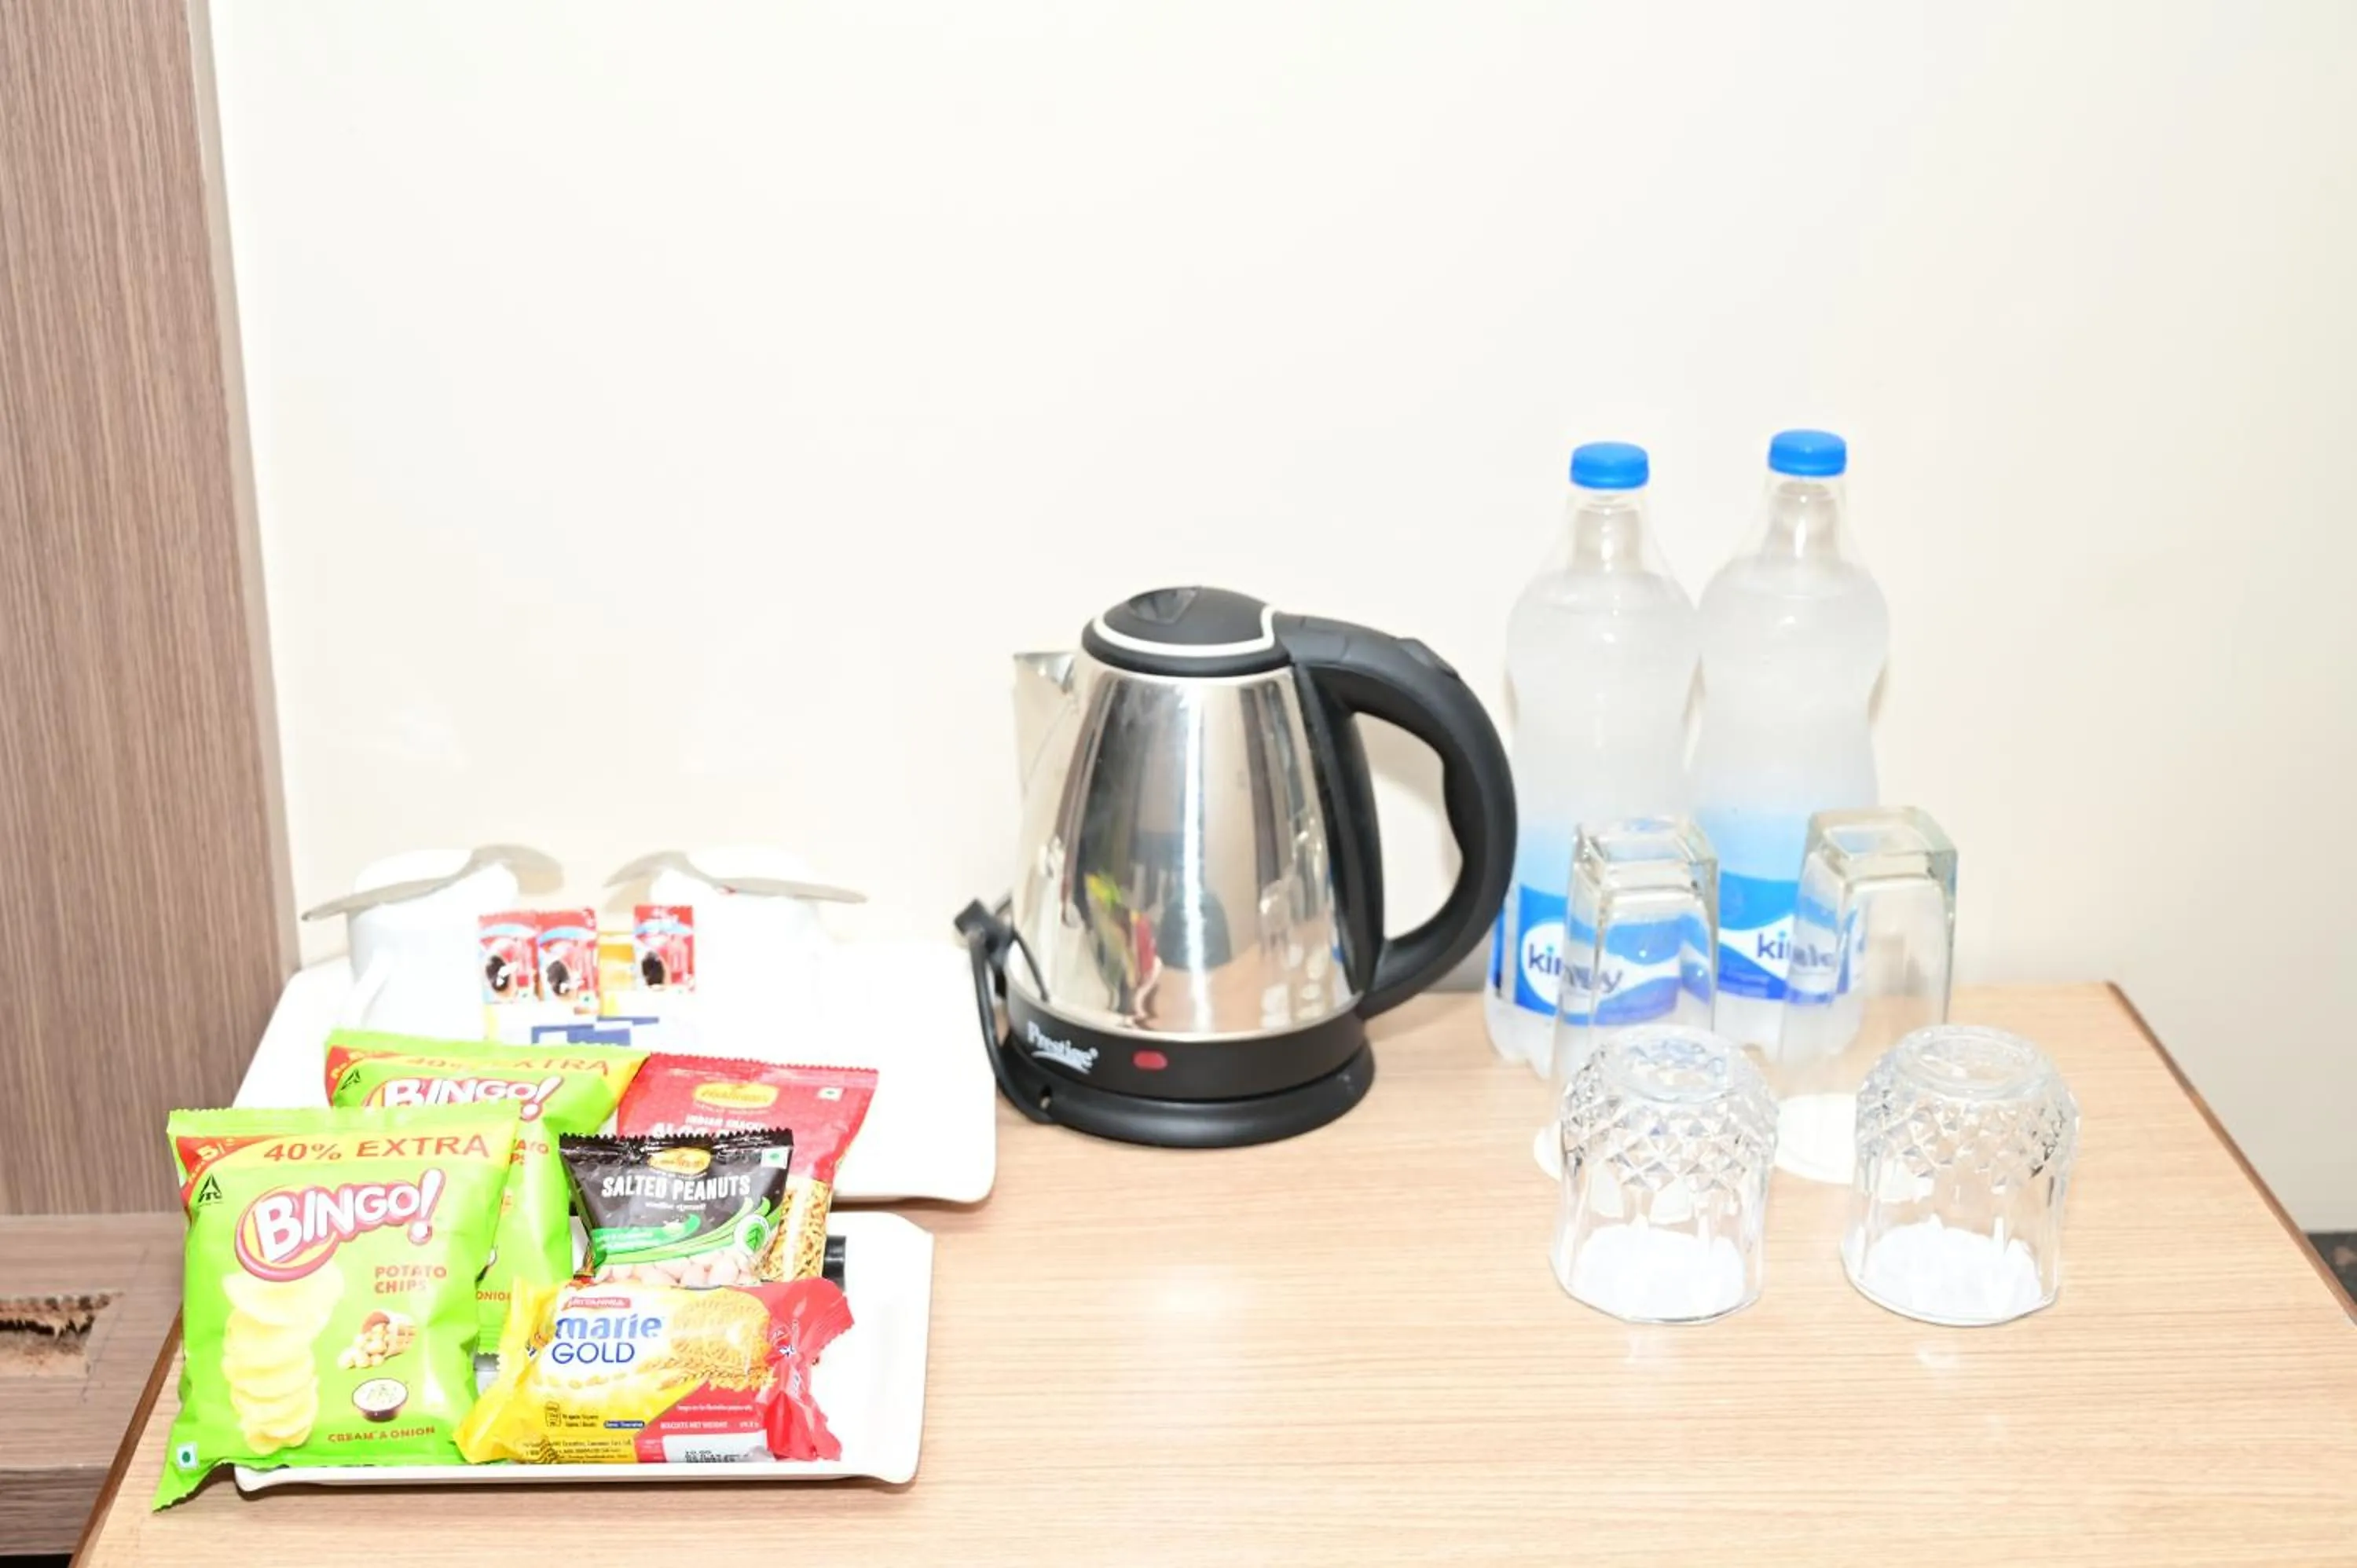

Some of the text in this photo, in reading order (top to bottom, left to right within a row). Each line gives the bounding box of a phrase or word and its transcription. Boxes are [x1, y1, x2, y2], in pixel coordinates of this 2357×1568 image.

[263, 1134, 489, 1162] 40% EXTRA
[601, 1175, 751, 1201] SALTED PEANUTS
[255, 1168, 445, 1263] BINGO!
[375, 1265, 447, 1280] POTATO
[375, 1280, 427, 1295] CHIPS
[555, 1313, 662, 1339] marie
[552, 1341, 636, 1365] GOLD
[327, 1431, 375, 1443] CREAM
[390, 1426, 436, 1439] ONION
